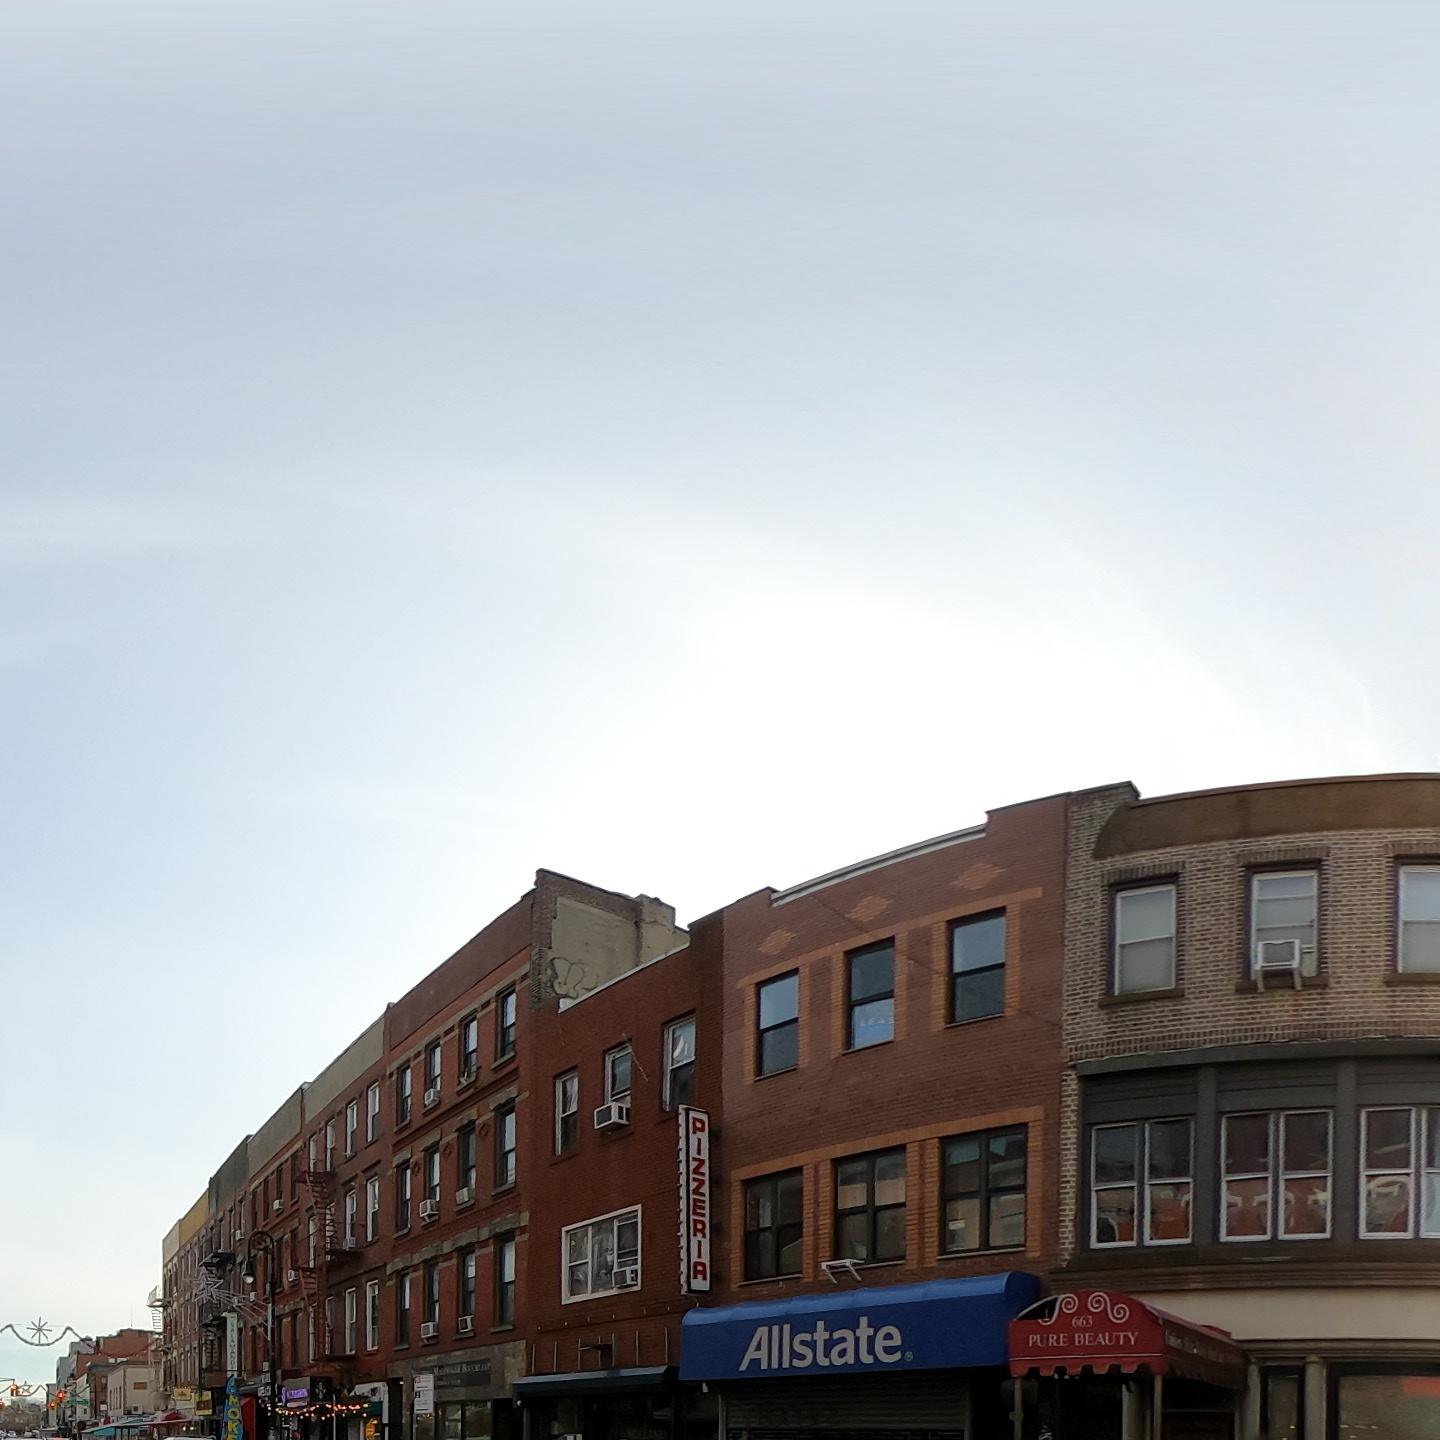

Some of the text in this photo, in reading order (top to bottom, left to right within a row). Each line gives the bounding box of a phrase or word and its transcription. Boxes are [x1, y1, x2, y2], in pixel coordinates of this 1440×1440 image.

[691, 1117, 708, 1280] PIZZERIA
[1028, 1331, 1140, 1348] PURE BEAUTY
[1071, 1315, 1094, 1328] 663
[738, 1316, 903, 1372] Allstate
